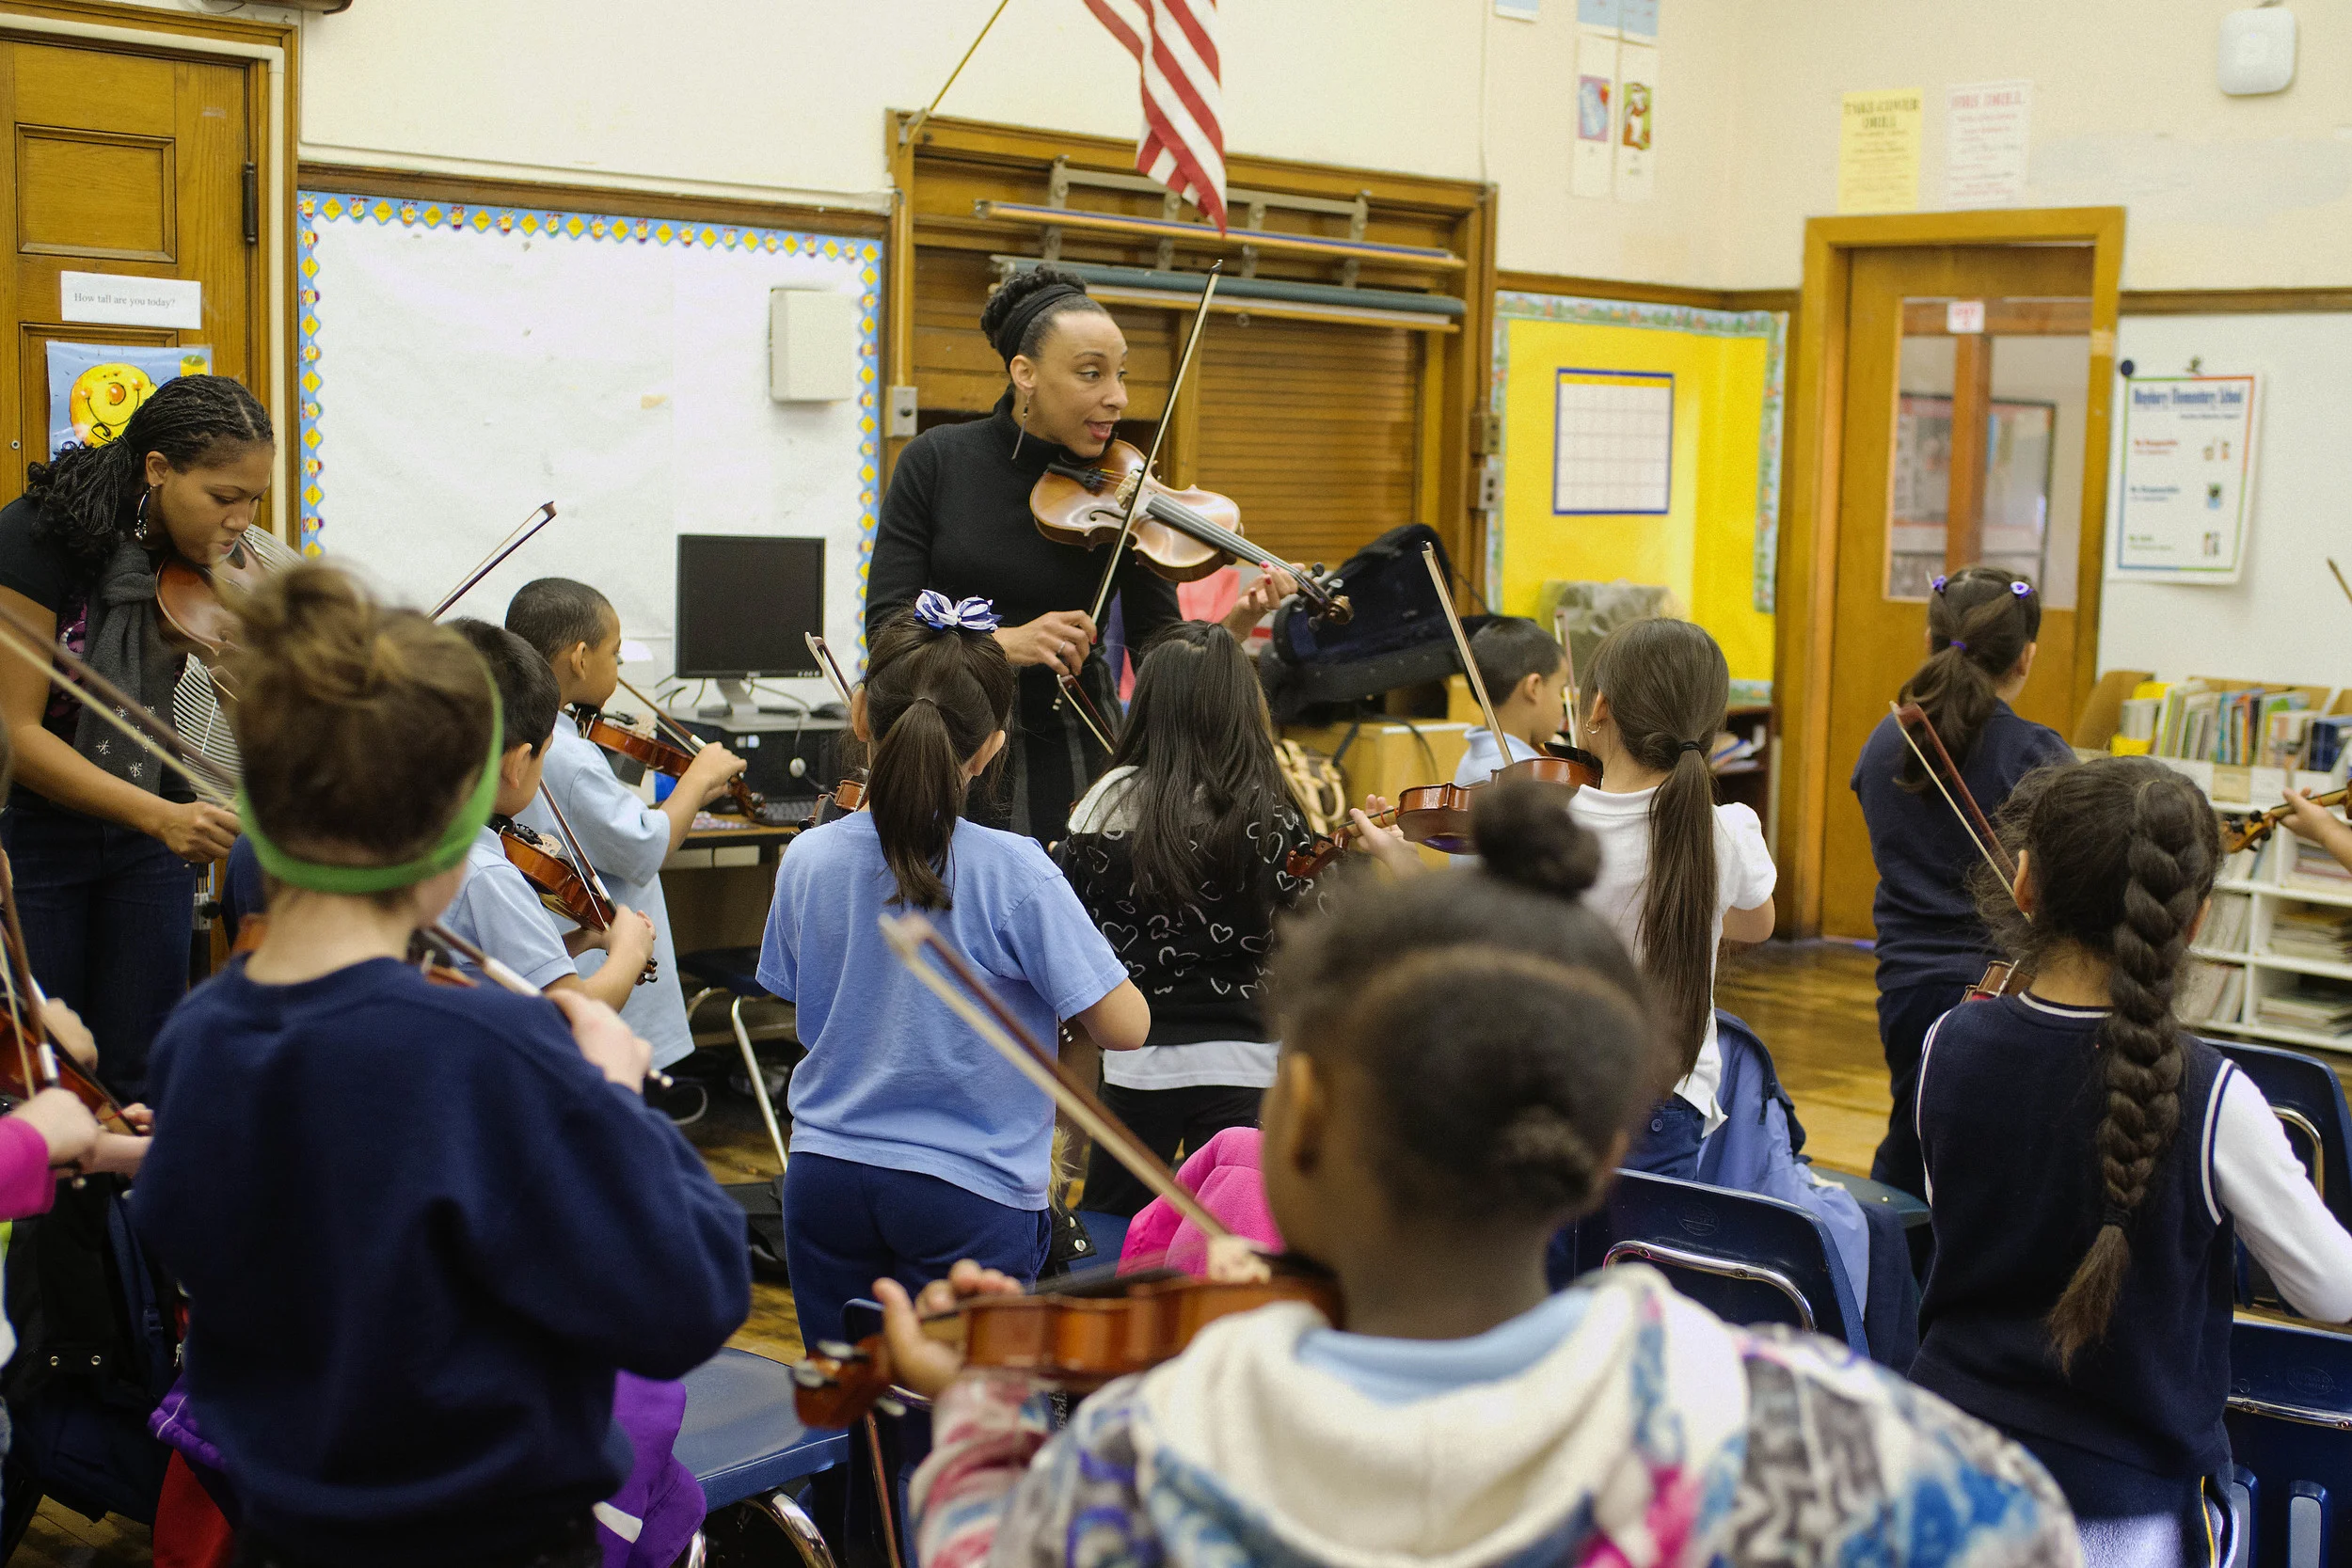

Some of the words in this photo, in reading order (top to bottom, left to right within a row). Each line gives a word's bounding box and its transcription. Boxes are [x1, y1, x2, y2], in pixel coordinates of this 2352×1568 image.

[1876, 97, 1920, 112] COVER
[74, 293, 95, 302] How
[97, 294, 112, 304] tall
[130, 298, 146, 307] you
[148, 298, 176, 309] today?
